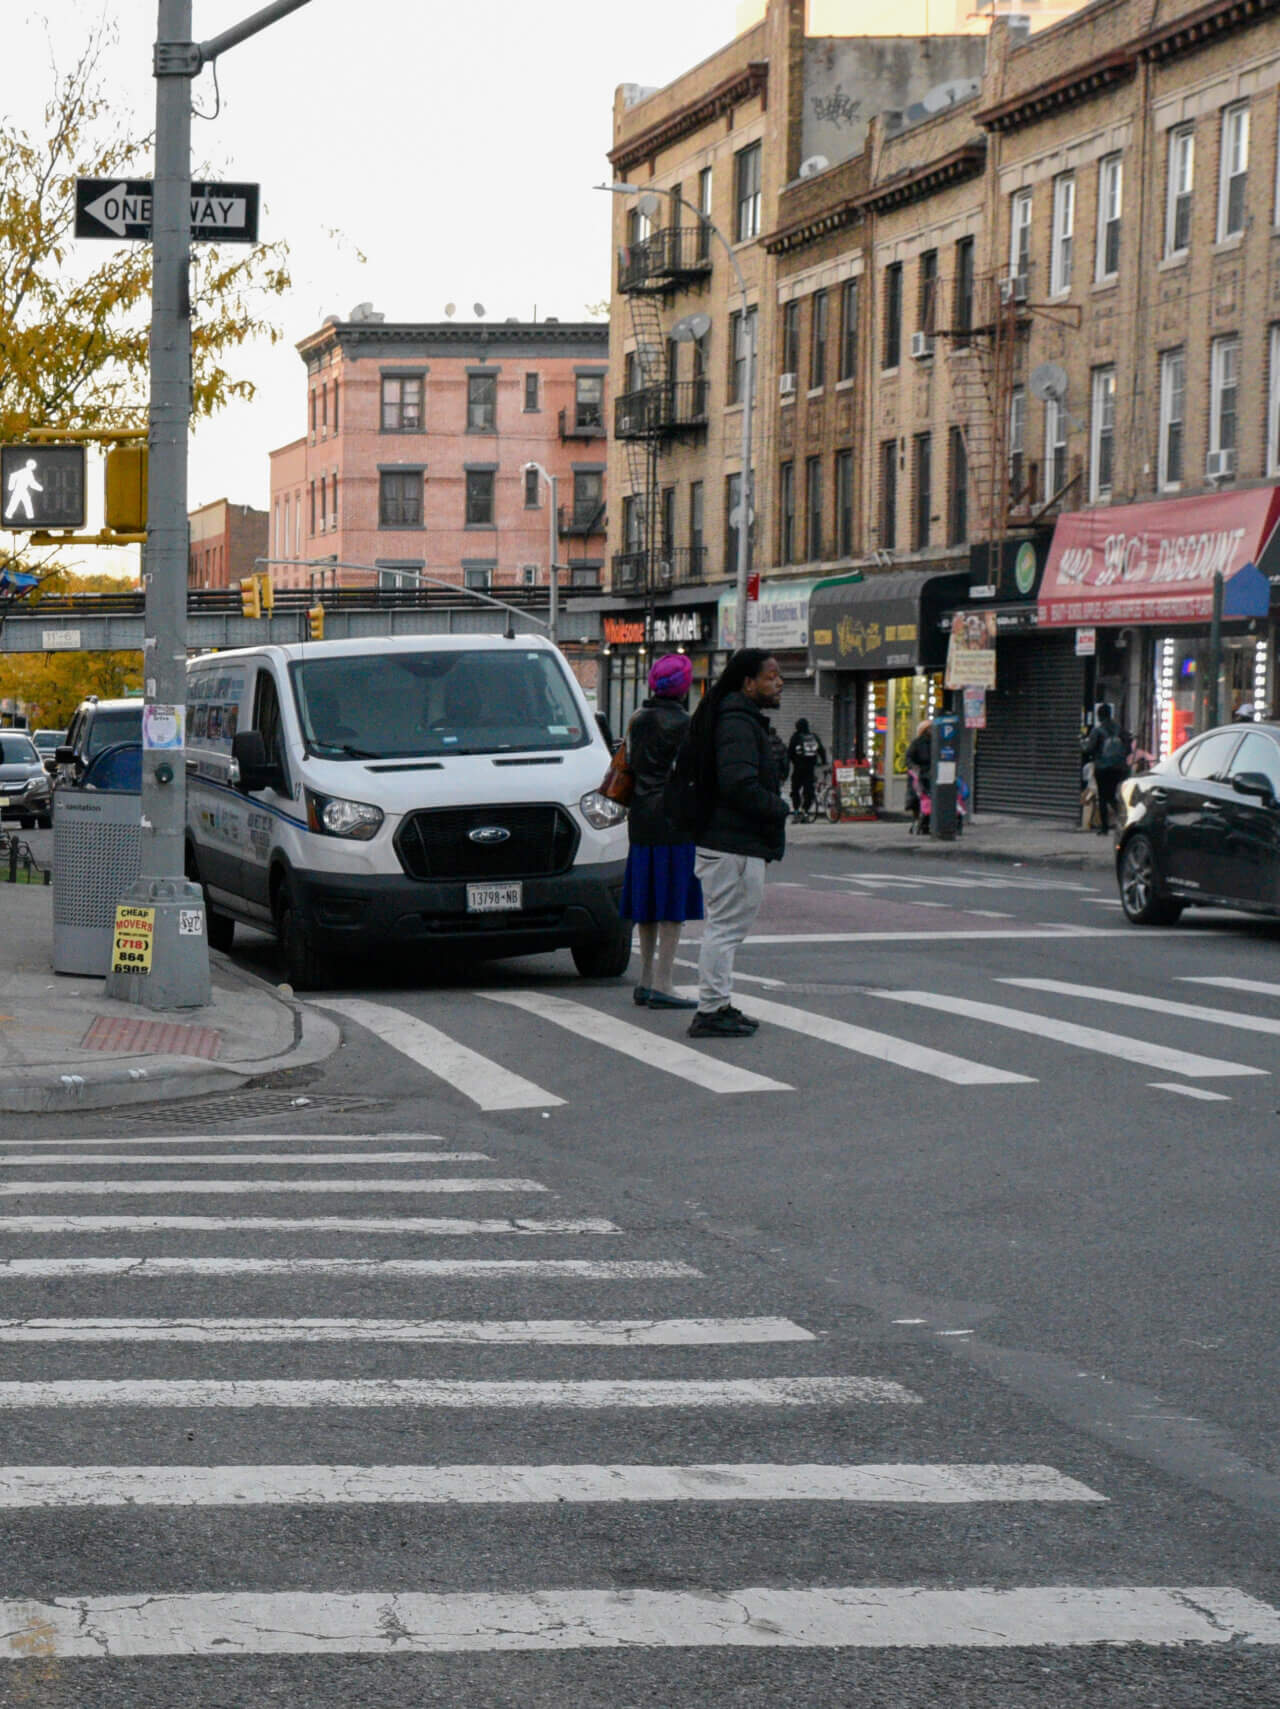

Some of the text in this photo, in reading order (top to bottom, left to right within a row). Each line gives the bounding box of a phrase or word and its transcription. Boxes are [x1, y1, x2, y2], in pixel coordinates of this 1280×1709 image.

[104, 198, 152, 221] ONE
[121, 909, 149, 918] CHEAP
[116, 919, 152, 932] MOVERS
[116, 938, 149, 951] (718)
[119, 952, 144, 962] 864
